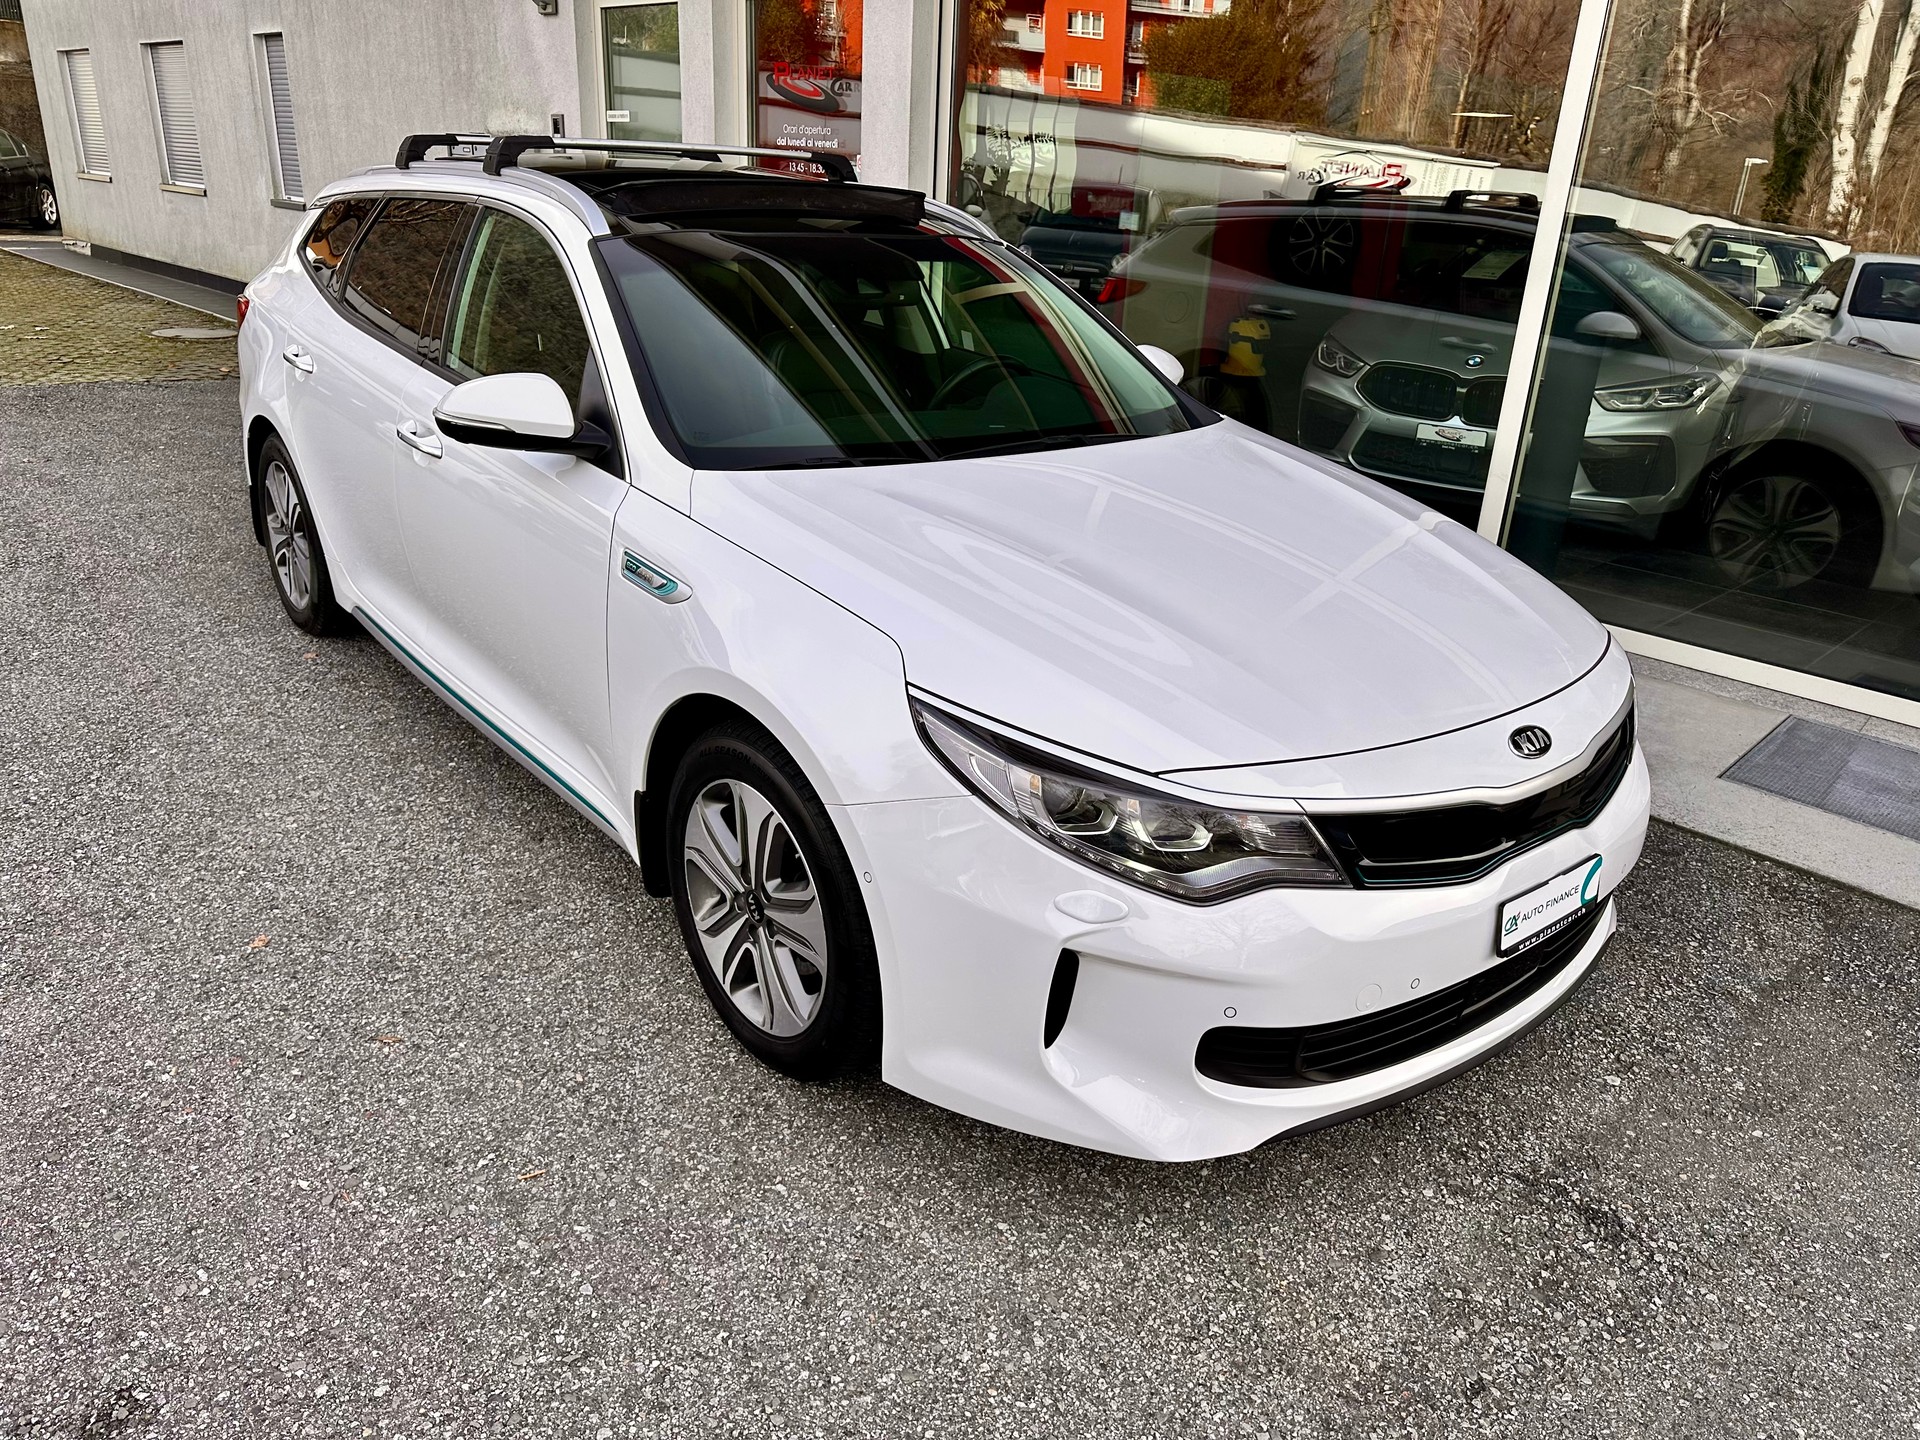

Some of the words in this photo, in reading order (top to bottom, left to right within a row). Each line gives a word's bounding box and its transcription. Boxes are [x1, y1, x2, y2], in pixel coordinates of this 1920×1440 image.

[773, 61, 834, 86] PLANET
[830, 78, 852, 97] CAR
[783, 124, 798, 134] Orari
[799, 124, 831, 136] d'apertura
[776, 136, 787, 146] dal
[807, 138, 814, 147] al
[1514, 728, 1550, 754] KIA
[714, 745, 751, 764] SEASON
[1521, 905, 1544, 923] AUTO
[1545, 884, 1580, 911] FINANCE
[1518, 907, 1586, 950] www.planetcar.ch
